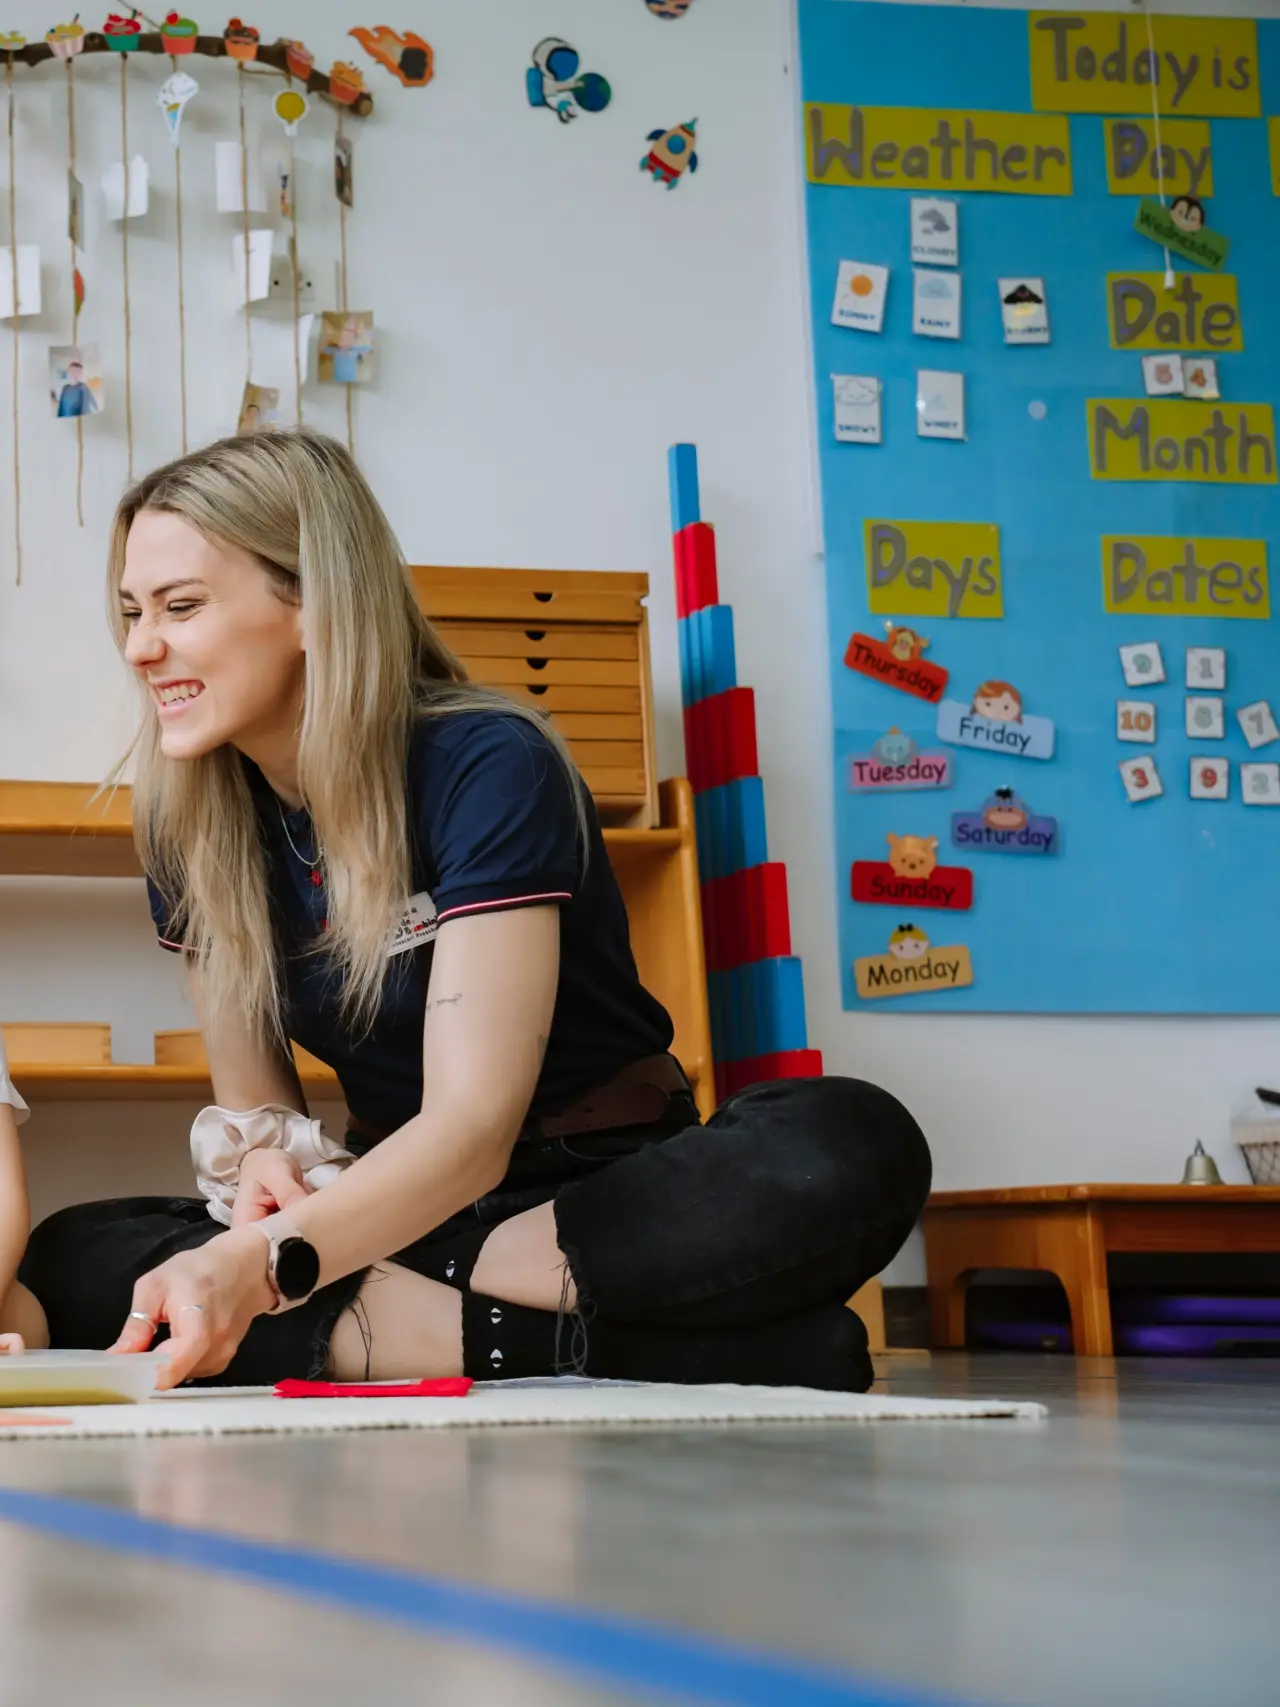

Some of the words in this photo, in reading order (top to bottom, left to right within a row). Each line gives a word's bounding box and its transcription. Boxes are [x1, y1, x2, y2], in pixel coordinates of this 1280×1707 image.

[1034, 16, 1200, 108] Today
[1211, 46, 1252, 92] is
[808, 105, 1067, 182] Weather
[1111, 121, 1211, 197] Day
[1110, 274, 1237, 347] Date
[1093, 403, 1274, 475] Month
[869, 523, 997, 617] Days
[1111, 541, 1264, 606] Dates
[852, 643, 942, 699] Thursday
[958, 717, 1032, 752] Friday
[1120, 709, 1152, 733] 10
[853, 758, 947, 784] Tuesday
[956, 822, 1054, 851] Saturday
[870, 875, 956, 906] Sunday
[866, 957, 961, 988] Monday
